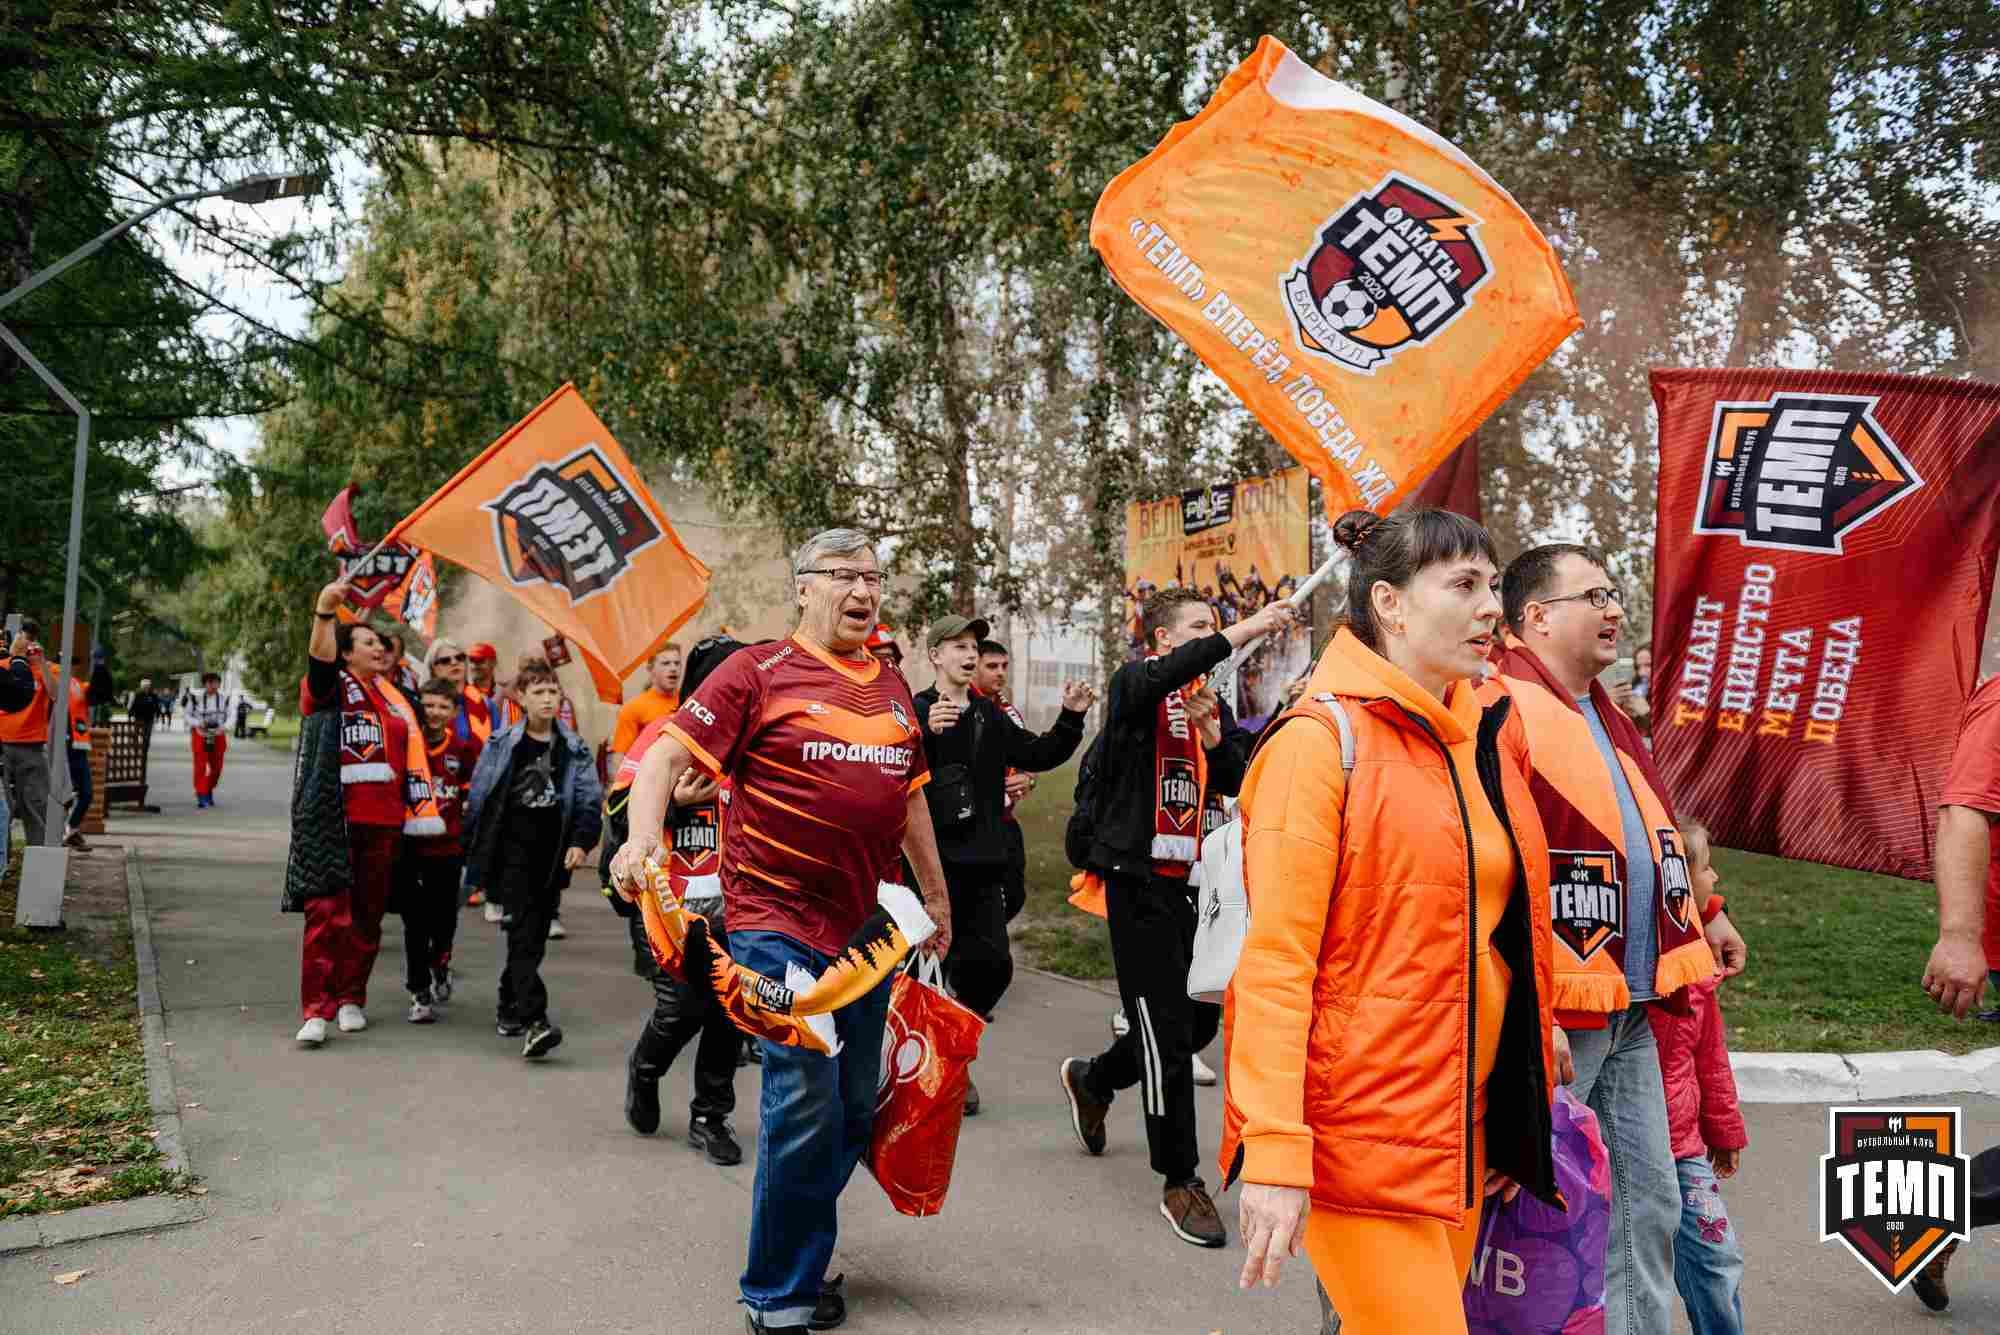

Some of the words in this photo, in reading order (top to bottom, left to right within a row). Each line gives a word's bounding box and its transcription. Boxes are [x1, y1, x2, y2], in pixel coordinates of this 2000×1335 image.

[1340, 207, 1456, 332] ТЕМП
[1383, 206, 1461, 283] ФАНАТЫ
[1357, 271, 1385, 299] 2020
[1129, 217, 1207, 302] «ТЕМП»
[1200, 292, 1292, 385] ВПЕРЁД
[1281, 373, 1366, 468] ПОБЕДА
[1292, 288, 1366, 364] БАРНАУЛ
[1756, 409, 1851, 532] ТЕМП
[1832, 466, 1848, 487] 2020
[1673, 596, 1725, 727] ТАЛАНТ
[1717, 561, 1777, 732] ЕДИНСТВО
[1759, 626, 1814, 738] МЕЧТА
[1804, 615, 1863, 745] ПОБЕДА
[344, 724, 379, 745] ТЕМП
[683, 698, 716, 726] ПСБ
[1163, 779, 1198, 807] ТЕМП
[676, 826, 715, 849] ТЕМП
[1570, 869, 1589, 882] ФК
[1550, 883, 1617, 925] ТЕМП
